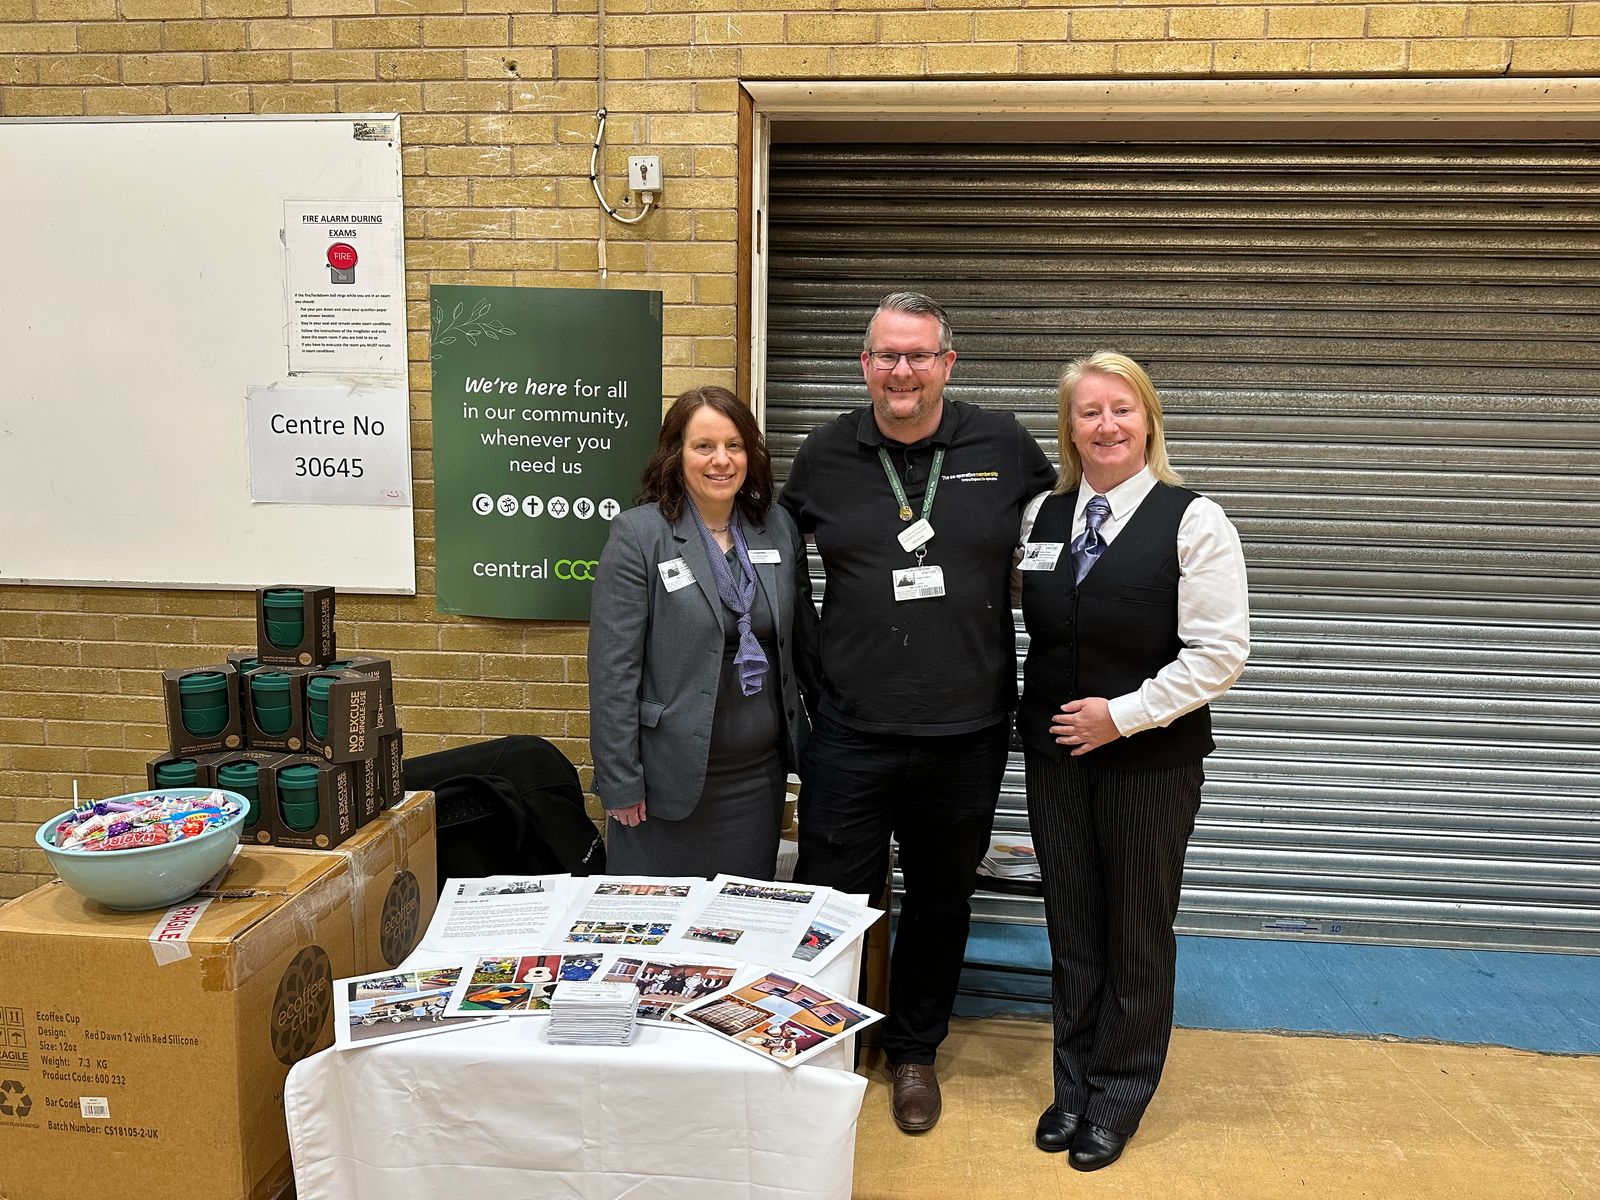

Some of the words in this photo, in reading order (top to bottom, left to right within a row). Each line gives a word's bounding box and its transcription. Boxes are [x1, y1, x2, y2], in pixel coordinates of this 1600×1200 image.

[302, 215, 319, 223] FIRE
[320, 215, 349, 223] ALARM
[351, 215, 383, 223] DURING
[328, 229, 357, 237] EXAMS
[334, 252, 352, 260] FIRE
[524, 378, 568, 396] here
[574, 379, 601, 398] for
[607, 381, 628, 398] all
[270, 413, 345, 435] Centre
[353, 415, 385, 436] No
[463, 402, 479, 419] in
[484, 408, 516, 420] our
[522, 407, 629, 429] community,
[480, 428, 572, 448] whenever
[576, 435, 611, 453] you
[294, 456, 364, 478] 30645
[509, 456, 556, 473] need
[562, 462, 582, 474] us
[472, 558, 548, 579] central
[322, 640, 328, 656] NO
[350, 691, 360, 733] EXCUSE
[349, 734, 358, 752] NO
[366, 798, 372, 816] NO
[340, 816, 346, 834] NO
[158, 906, 198, 942] FRAGILE
[384, 898, 416, 934] ecoffee
[392, 918, 409, 938] cup
[278, 976, 326, 1027] ecoffee
[36, 1011, 64, 1023] Ecoffee
[65, 1014, 80, 1026] Cup
[291, 1000, 314, 1031] cup
[38, 1026, 66, 1038] Design:
[84, 1030, 99, 1040] Red
[101, 1031, 122, 1042] Dawn
[123, 1033, 132, 1042] 12
[133, 1033, 151, 1043] with
[152, 1034, 167, 1044] Red
[169, 1035, 199, 1046] Silicone
[0, 1050, 28, 1060] AGILE
[39, 1041, 57, 1051] Size:
[59, 1042, 77, 1052] 12oz
[41, 1055, 70, 1068] Weight:
[78, 1058, 91, 1068] 7.3
[96, 1059, 108, 1069] KG
[42, 1071, 71, 1082] Product
[72, 1072, 94, 1083] Code:
[95, 1074, 109, 1084] 600
[112, 1074, 126, 1085] 232
[45, 1097, 58, 1107] Bar
[48, 1121, 68, 1132] Batch
[69, 1122, 101, 1134] Number:
[104, 1126, 159, 1139] CS18105-2-UK
